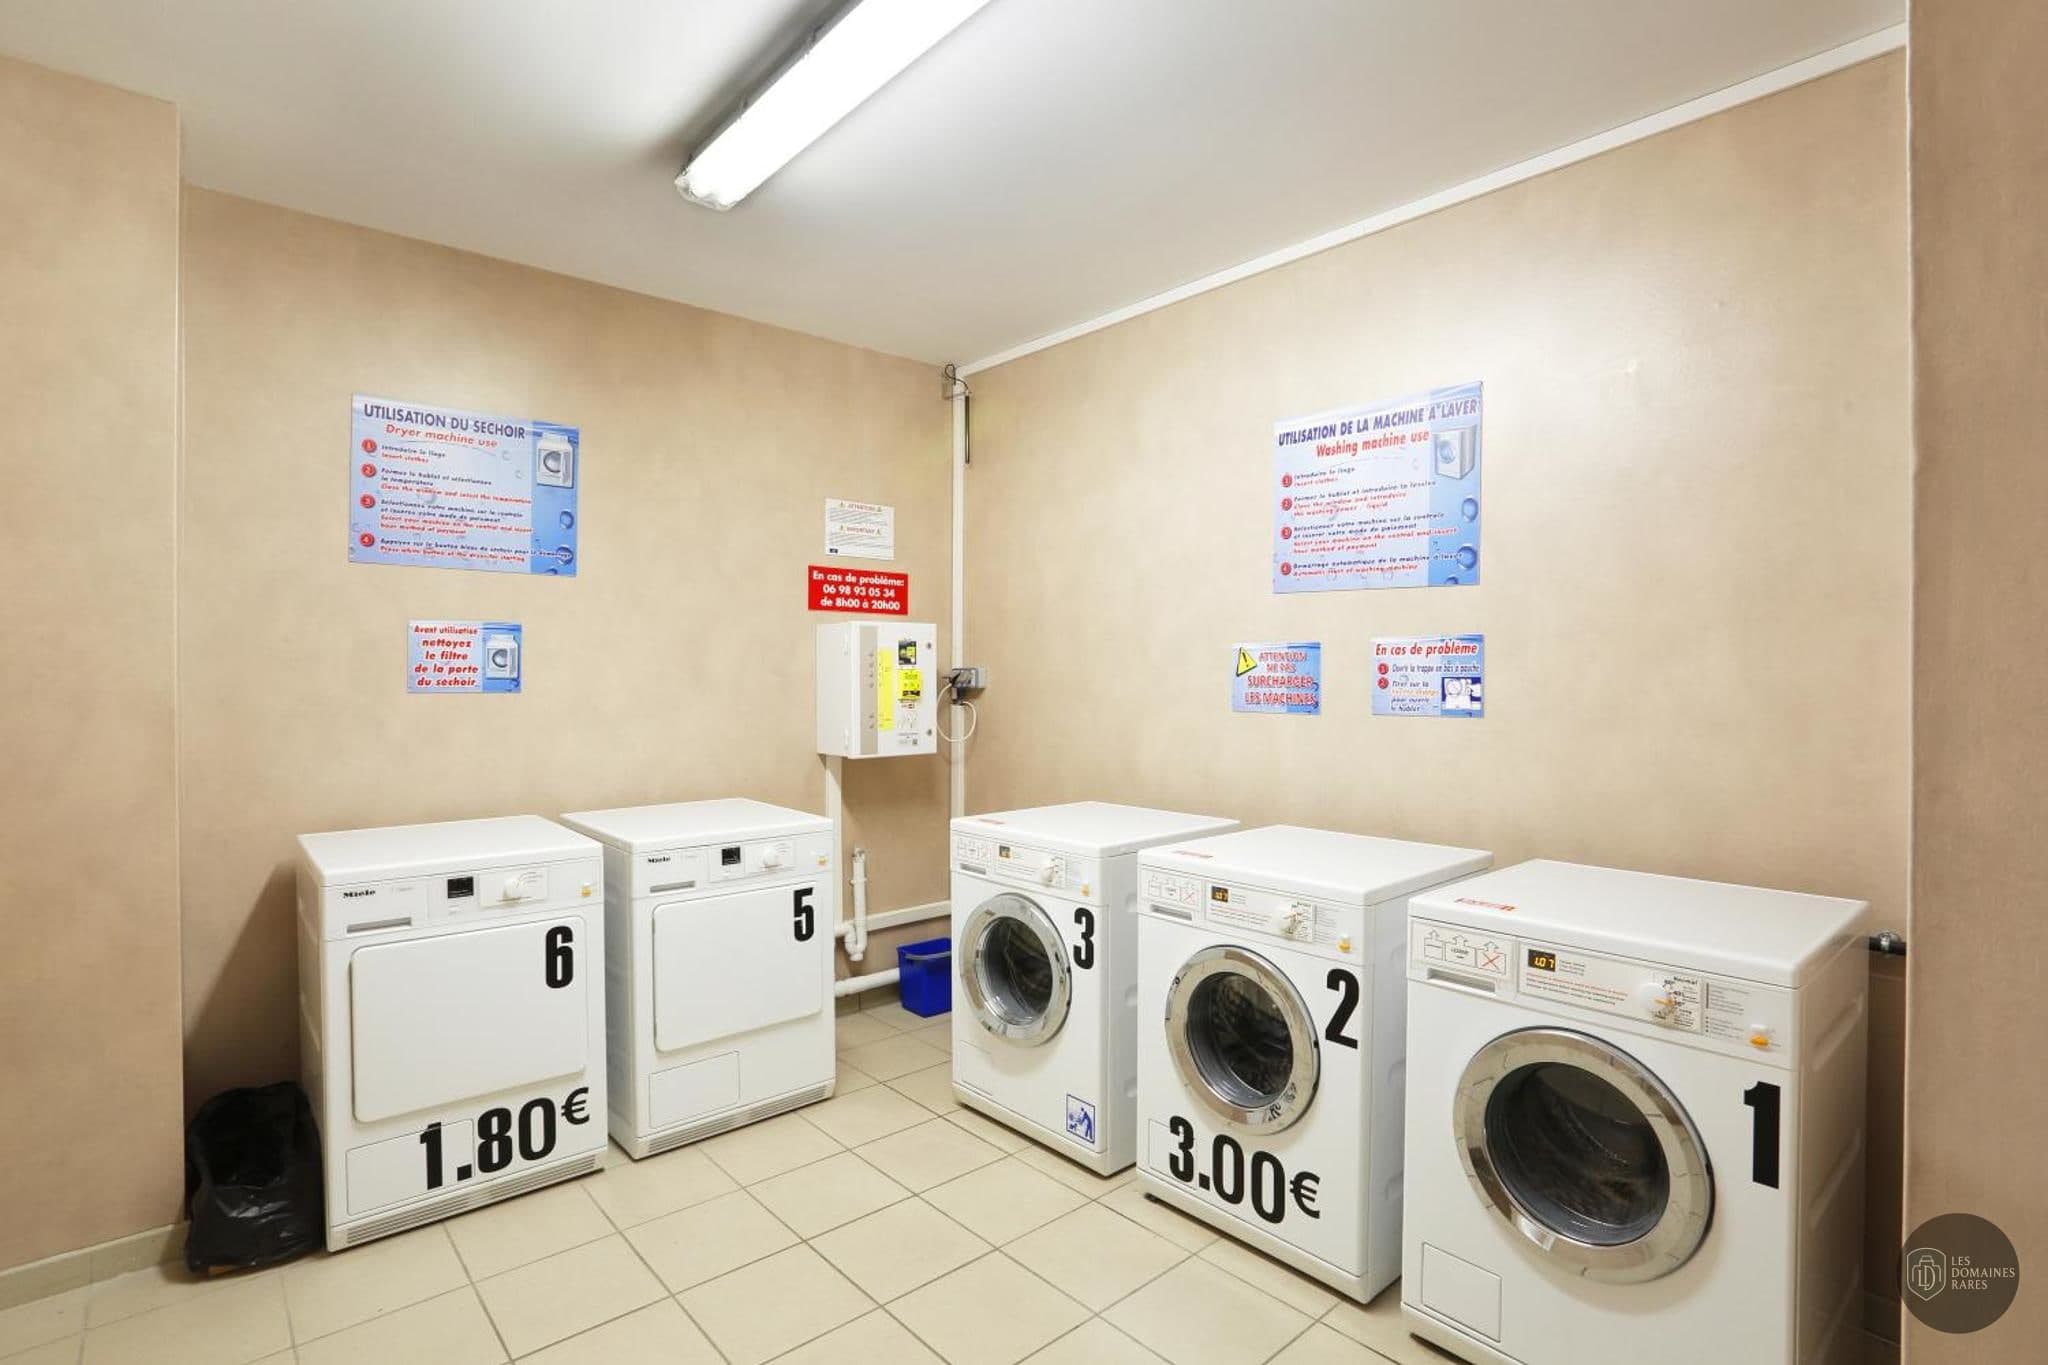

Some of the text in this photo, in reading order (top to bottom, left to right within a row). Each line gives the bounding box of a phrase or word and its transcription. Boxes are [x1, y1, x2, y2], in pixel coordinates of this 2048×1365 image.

[364, 404, 525, 439] UTILISATION DU SECHOIR
[1279, 423, 1336, 446] UTILISATION
[1340, 421, 1353, 435] DE
[1357, 418, 1369, 433] LA
[1373, 407, 1424, 430] MACHINE
[386, 423, 498, 448] Dryer machine use
[1316, 430, 1430, 458] Washing machine use
[813, 571, 825, 580] En
[827, 574, 842, 582] cas
[845, 573, 857, 583] de
[822, 584, 895, 598] 06 98 93 05 34
[820, 597, 833, 606] de
[835, 597, 860, 608] 8h00
[872, 599, 901, 611] 20h00
[422, 638, 472, 649] nettoyez
[1375, 643, 1387, 656] En
[1390, 645, 1406, 655] cas
[1410, 642, 1423, 655] de
[425, 650, 468, 660] le filtre
[414, 664, 479, 676] de la porte
[417, 677, 431, 686] du
[1247, 675, 1314, 688] SURCHARGER
[1244, 692, 1316, 705] LES MACHINES
[343, 889, 376, 899] Miele
[792, 887, 815, 942] 5
[1073, 907, 1095, 970] 3
[544, 925, 574, 989] 6
[1324, 968, 1360, 1049] 2
[419, 1087, 591, 1190] 1.80€
[1743, 1080, 1781, 1190] 1
[1169, 1115, 1320, 1224] 3.00€
